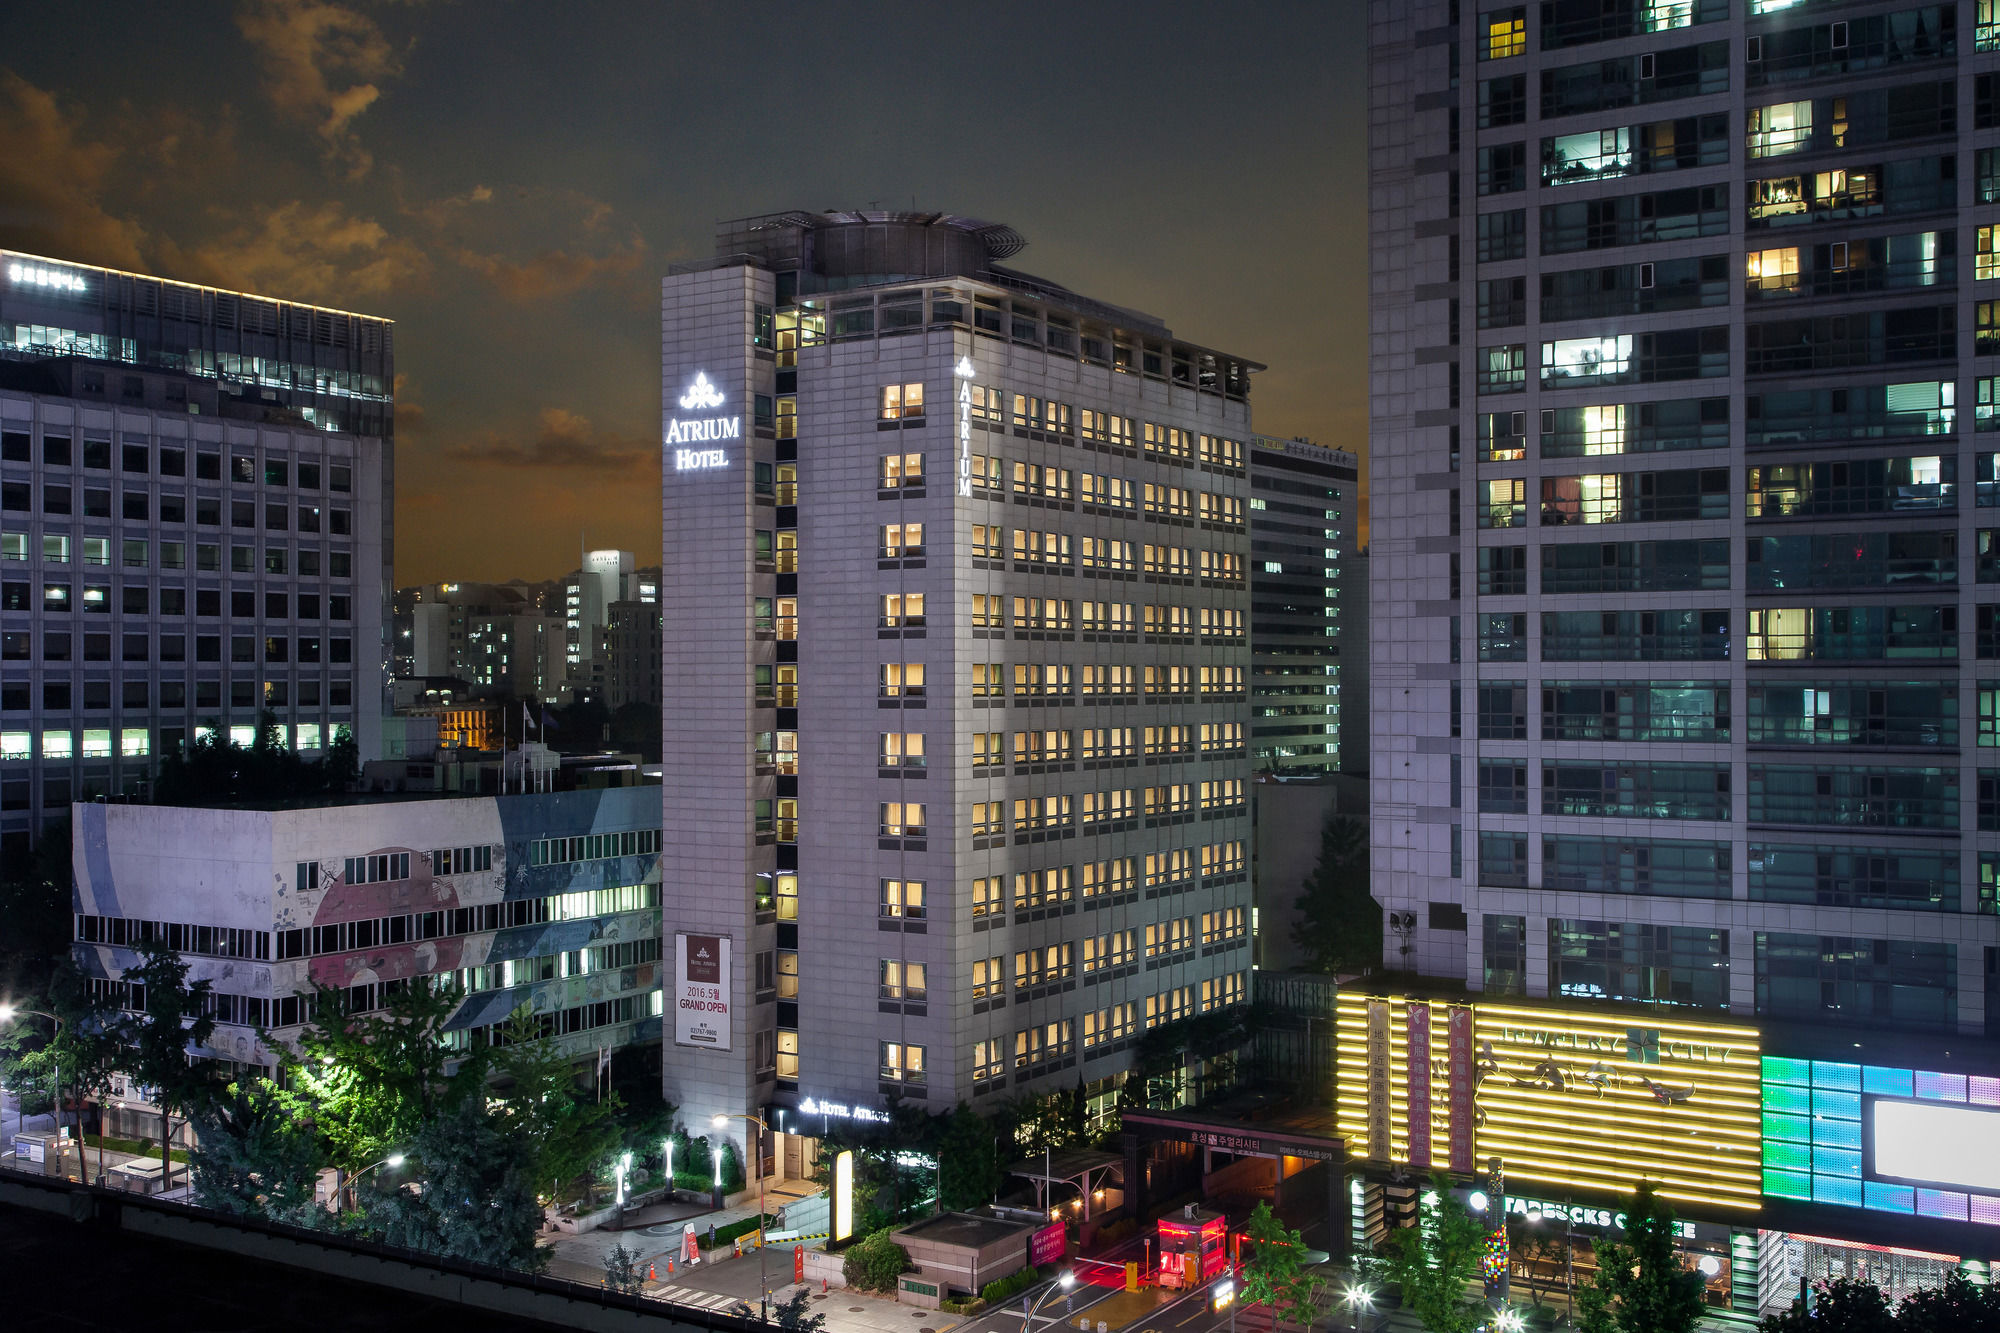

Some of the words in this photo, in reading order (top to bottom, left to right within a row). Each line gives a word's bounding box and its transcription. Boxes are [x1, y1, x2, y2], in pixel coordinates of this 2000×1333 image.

[666, 417, 740, 444] ATRIUM
[958, 380, 971, 496] ATRIUM
[676, 449, 729, 470] HOTEL
[680, 998, 706, 1011] GRAND
[707, 1002, 728, 1014] OPEN
[1669, 1041, 1732, 1063] CITY
[820, 1101, 850, 1117] HOTEL
[1504, 1197, 1611, 1227] TARBUCKS
